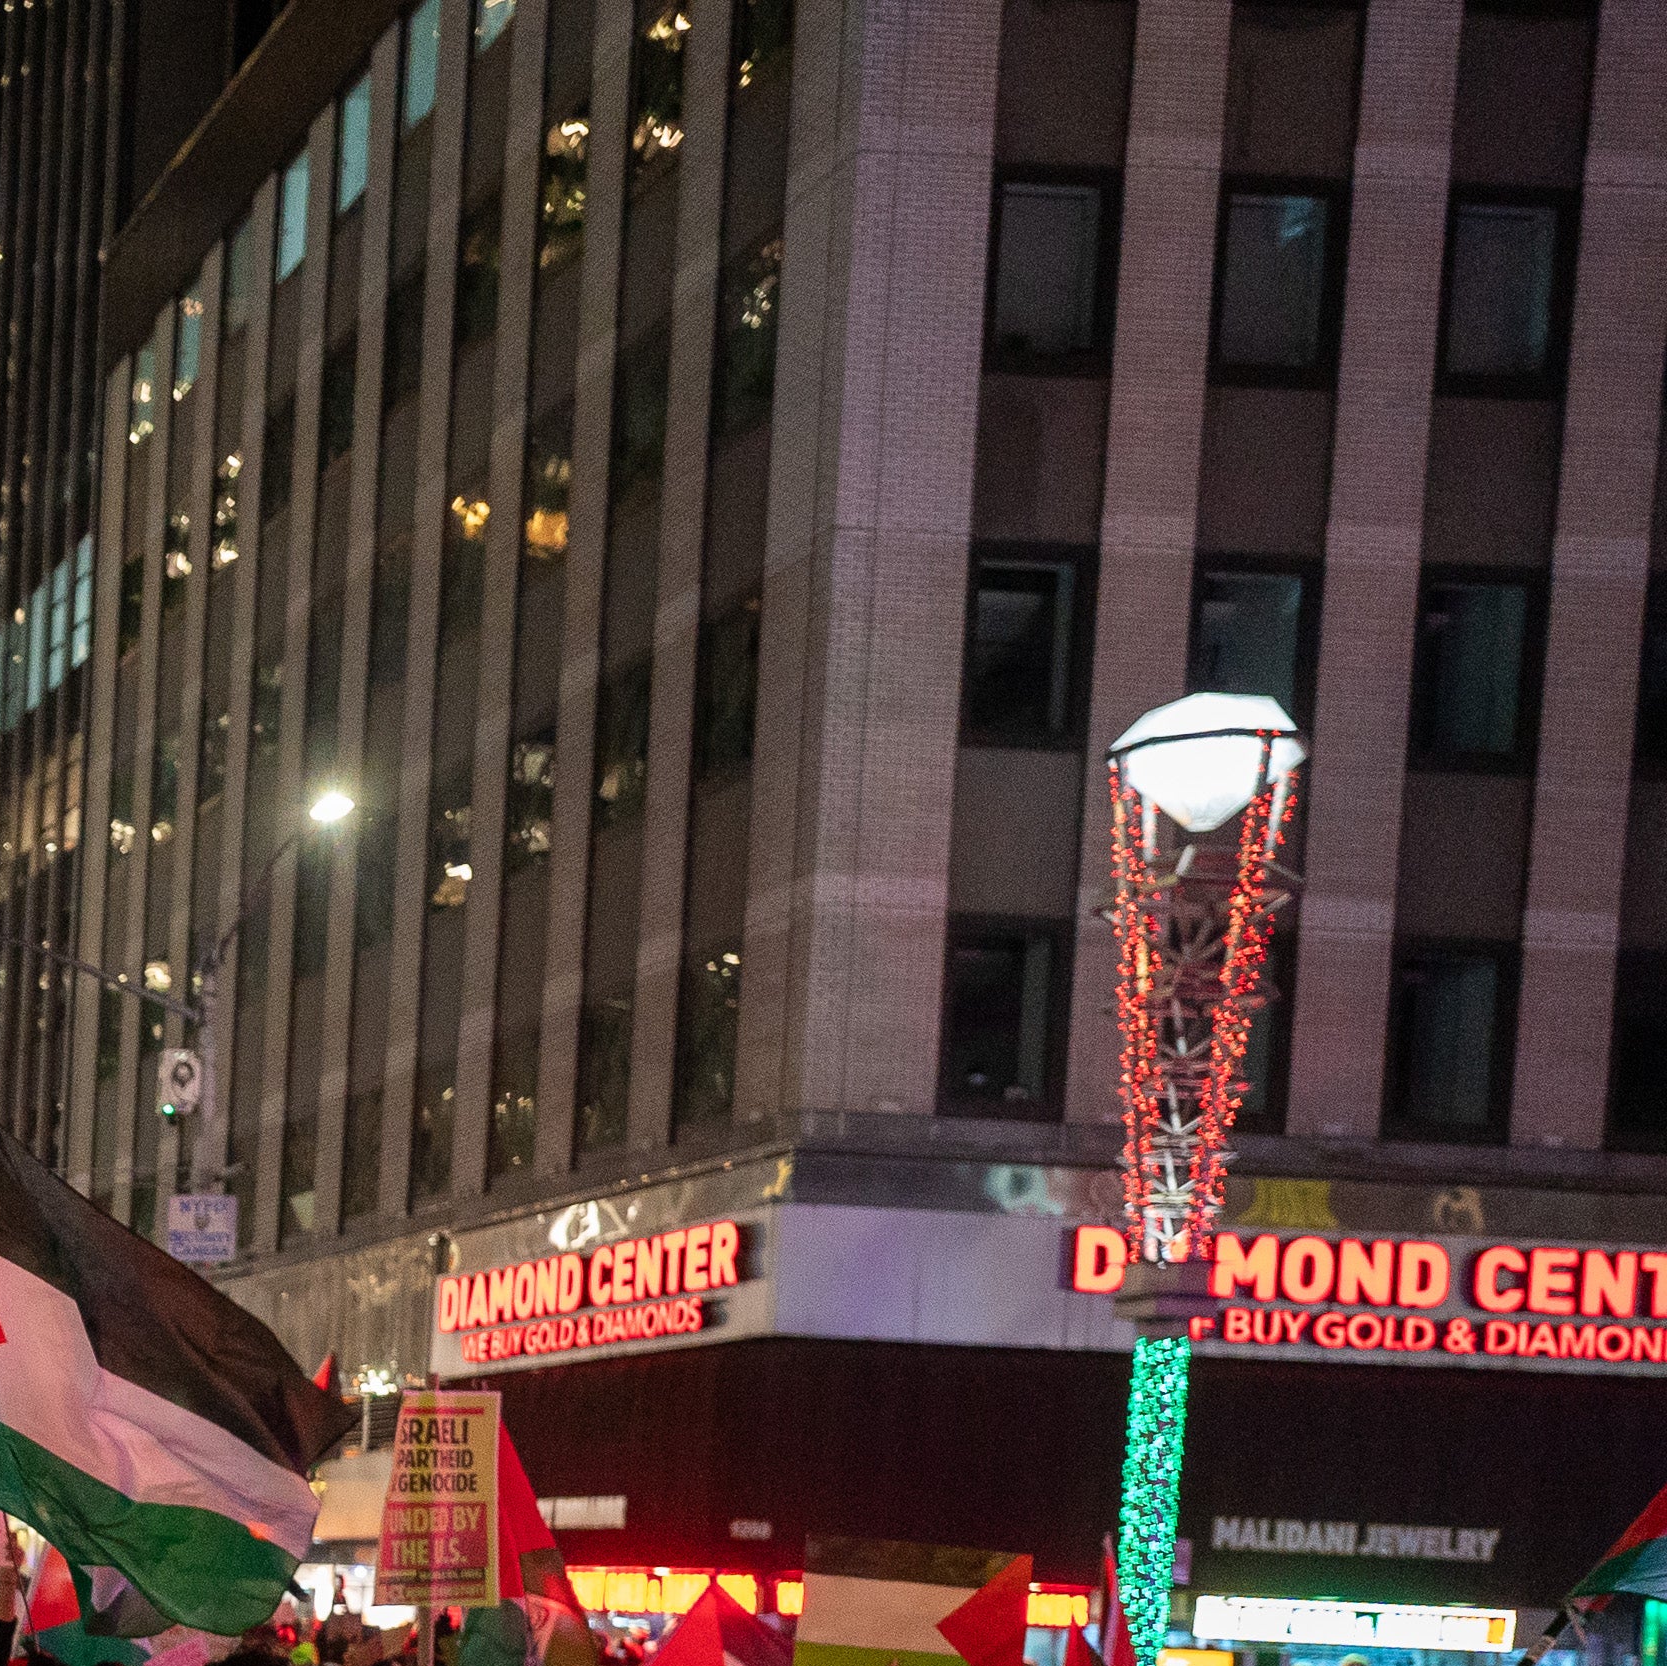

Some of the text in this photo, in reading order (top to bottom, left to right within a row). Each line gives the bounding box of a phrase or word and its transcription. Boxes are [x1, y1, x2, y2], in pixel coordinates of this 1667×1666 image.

[438, 1220, 740, 1334] DIAMOND CENTER
[1073, 1225, 1451, 1309] DMOND
[461, 1297, 703, 1362] WE BUY GOLD & DIAMONDS
[1223, 1307, 1310, 1345] BUY
[1313, 1310, 1437, 1352] GOLD
[1442, 1316, 1478, 1355] &
[1483, 1319, 1667, 1364] DIAMON
[400, 1418, 470, 1445] SRAELI
[398, 1473, 478, 1493] GENOCIDE
[388, 1503, 482, 1534] UNDED BY
[1213, 1516, 1501, 1565] MALIDANI JEWELRY
[390, 1539, 430, 1565] THE
